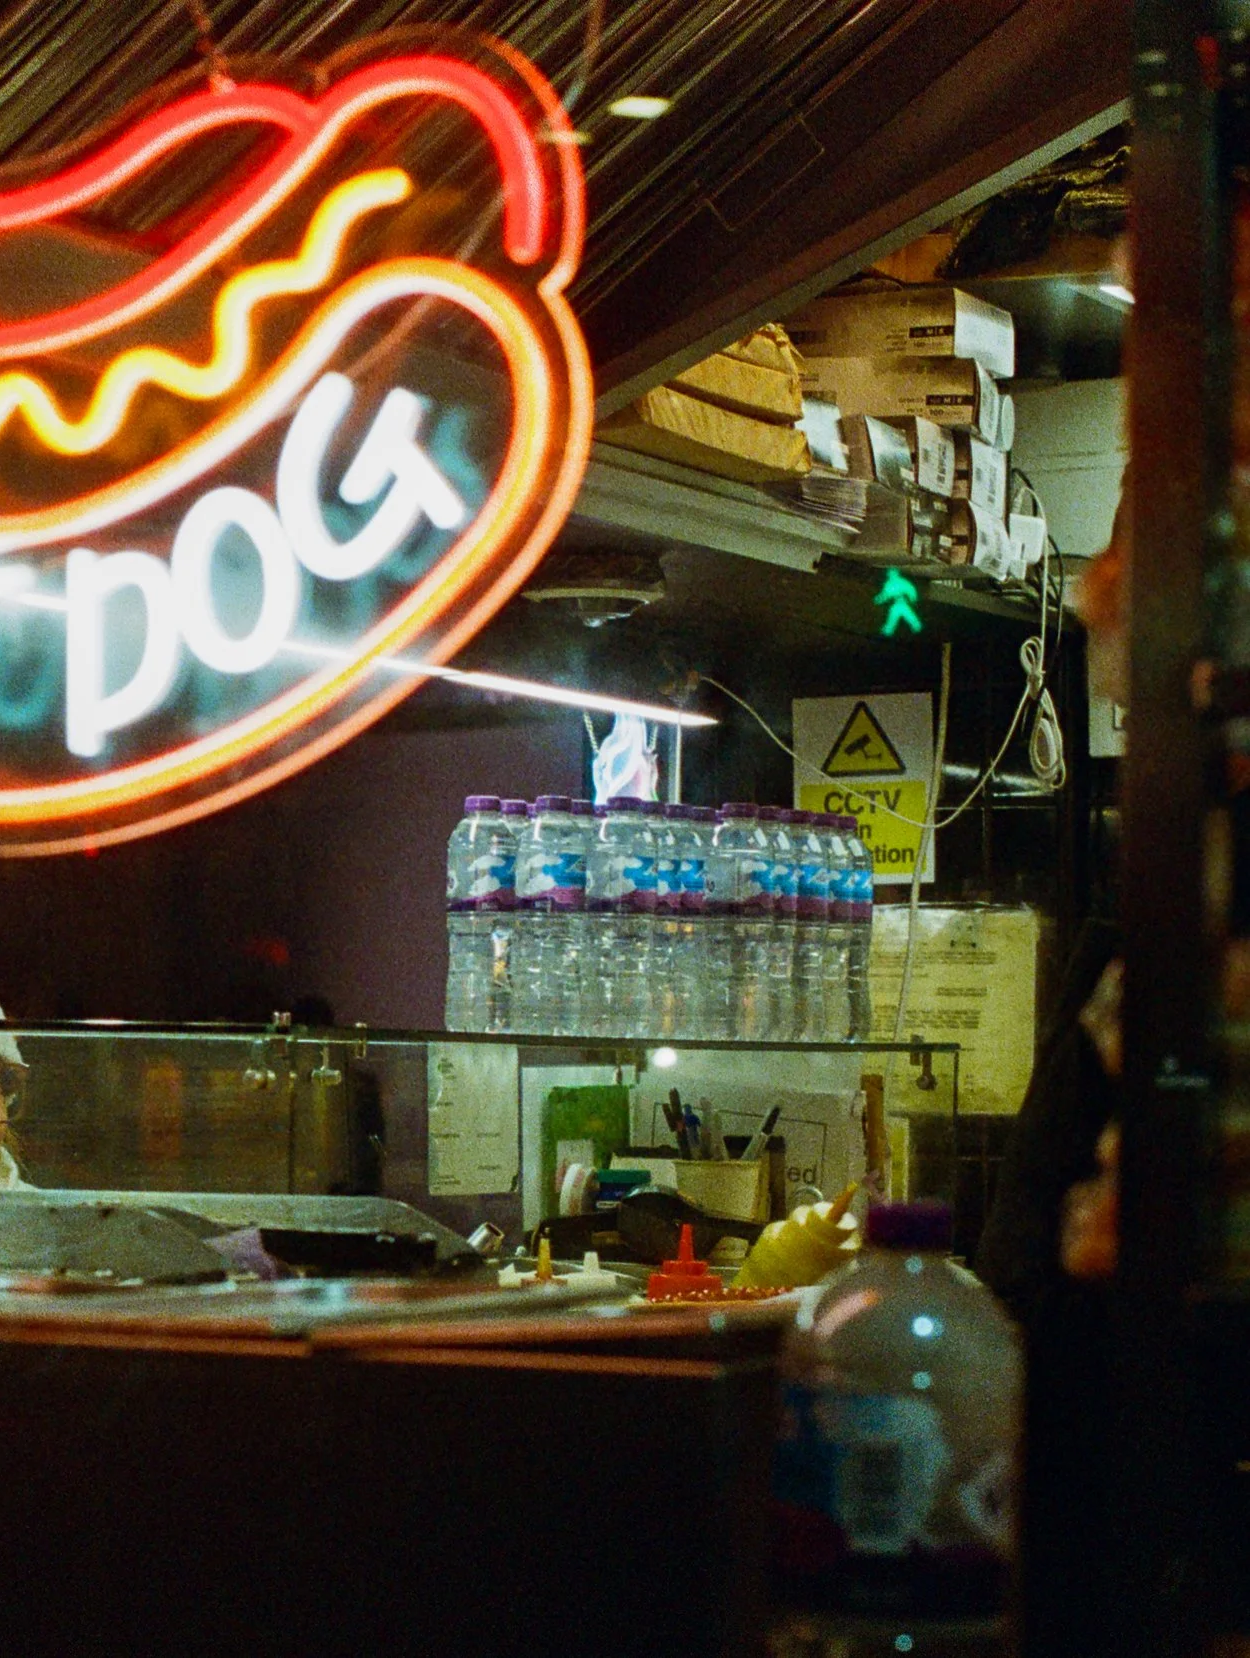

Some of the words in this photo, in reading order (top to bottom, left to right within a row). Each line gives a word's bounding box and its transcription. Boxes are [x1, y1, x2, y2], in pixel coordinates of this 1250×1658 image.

[65, 372, 467, 758] DOG
[824, 789, 901, 815] CCTV
[858, 824, 872, 839] n
[873, 845, 915, 864] tion
[787, 1164, 818, 1185] ed
